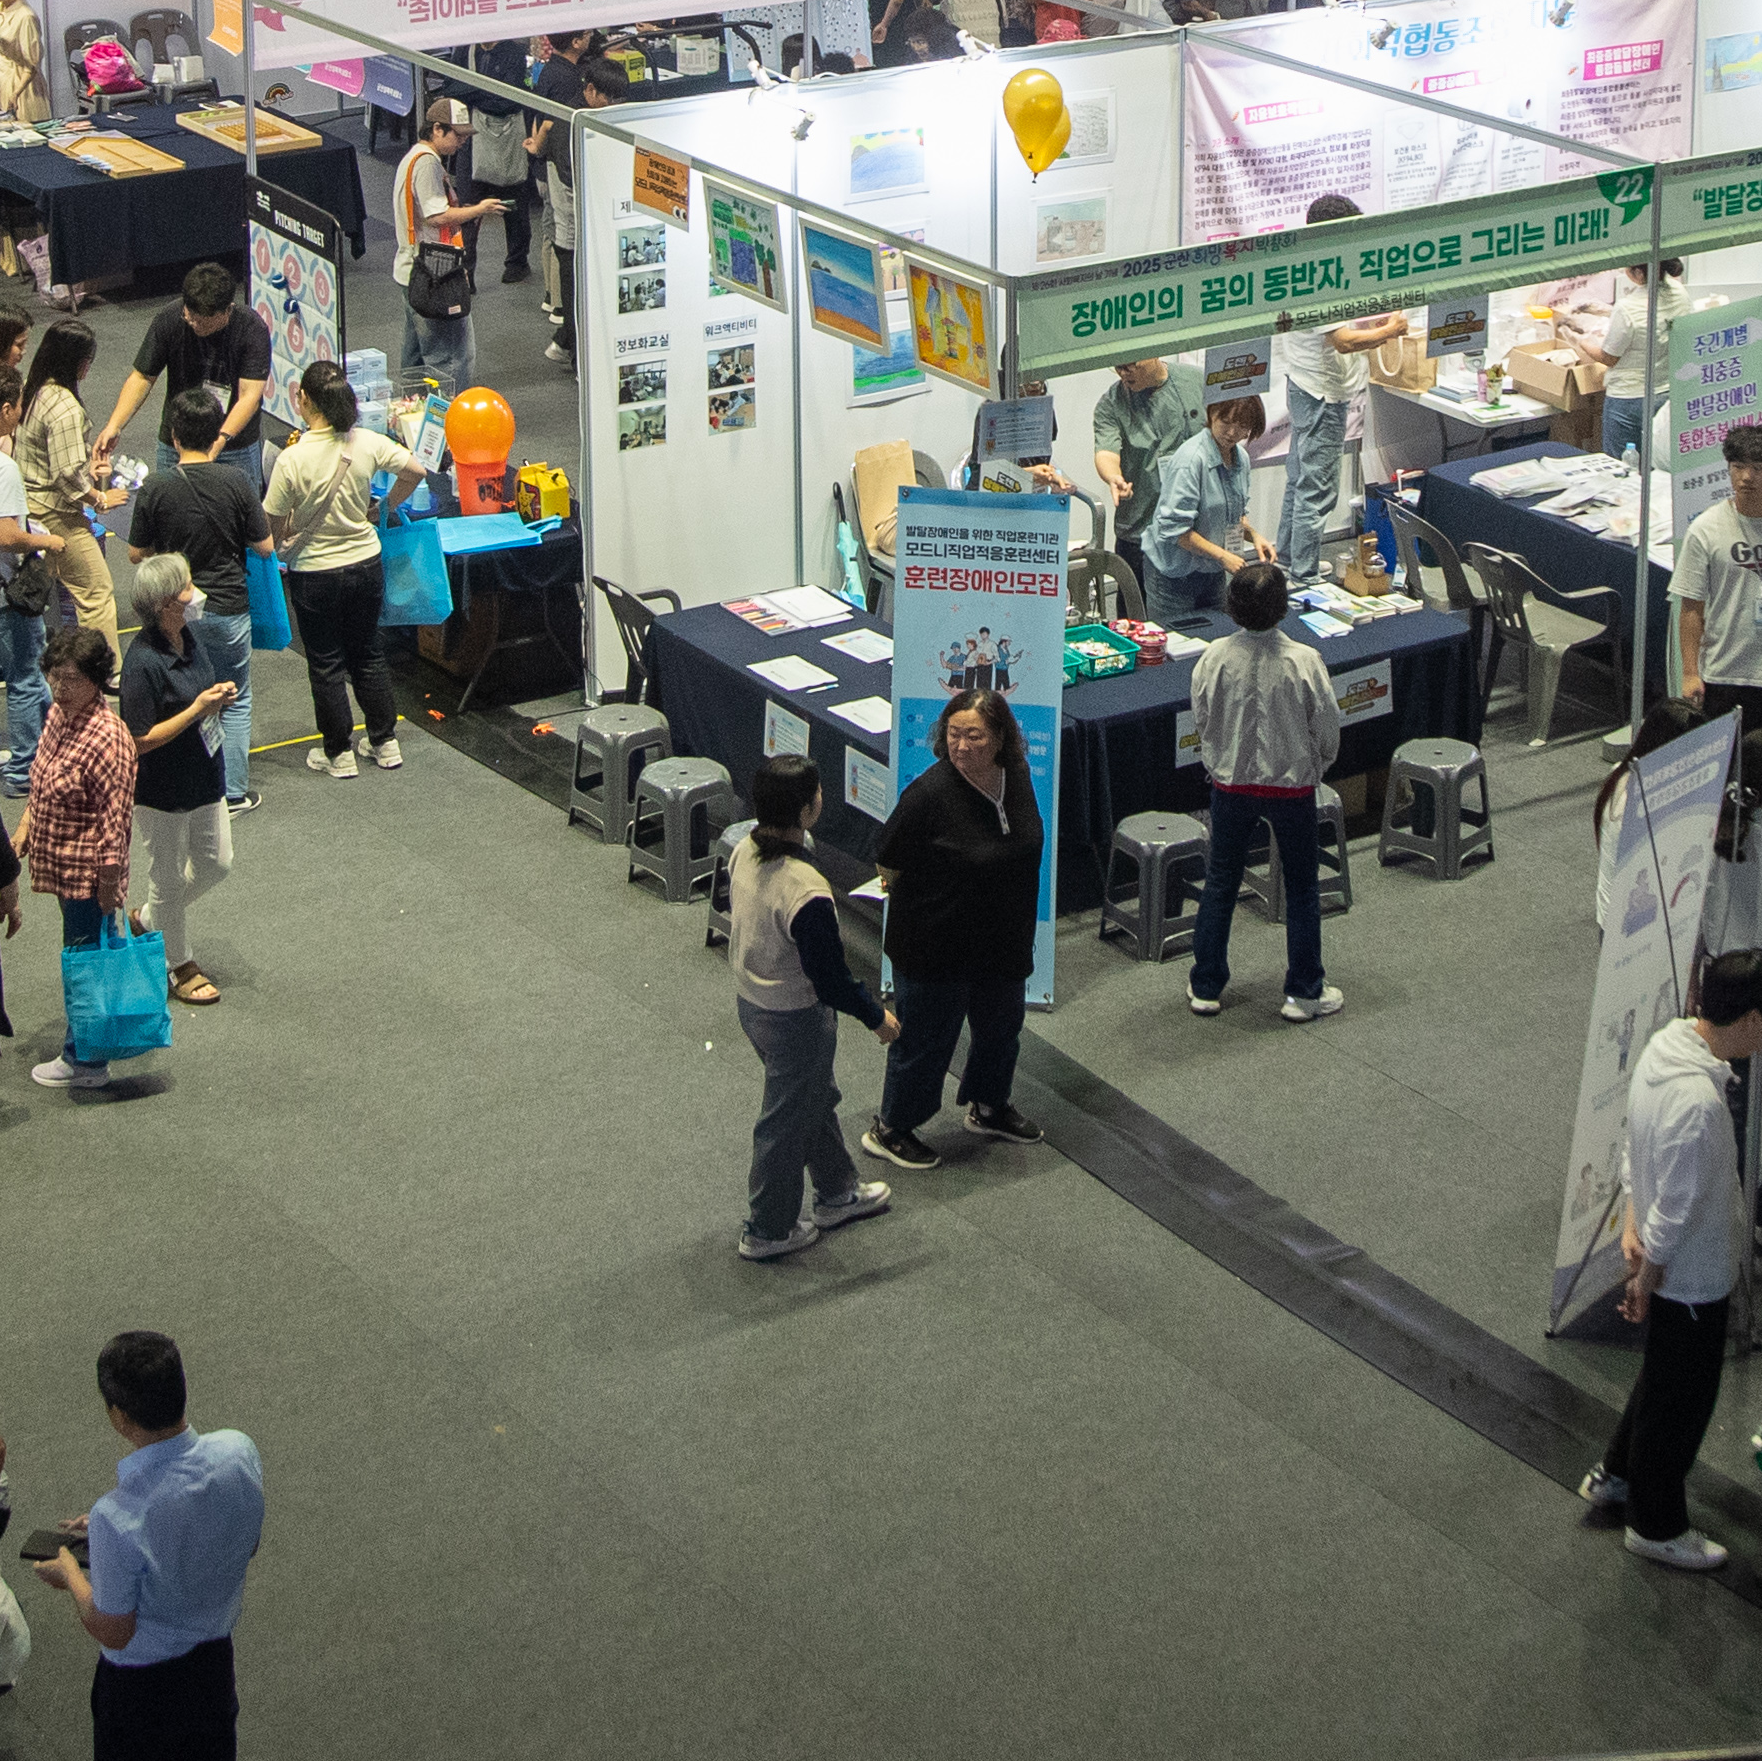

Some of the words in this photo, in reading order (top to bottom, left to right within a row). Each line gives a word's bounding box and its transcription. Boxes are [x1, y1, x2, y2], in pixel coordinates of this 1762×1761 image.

[1615, 174, 1644, 204] 22
[1070, 284, 1184, 338] 장애인의
[1199, 272, 1254, 314] 꿈의
[1262, 255, 1351, 305] 동반자,
[1359, 235, 1462, 280] 직업으로
[1470, 220, 1546, 263] 그리는
[1553, 206, 1611, 247] 미래!
[1122, 257, 1162, 279] 2025
[1163, 250, 1190, 270] 군산
[1223, 239, 1255, 261] 복지
[703, 318, 758, 337] 워크액티비티
[1693, 323, 1749, 356] 주간개별
[616, 333, 670, 354] 정보화교실
[1699, 356, 1743, 385] 최중증
[1686, 383, 1757, 421] 발달장애인
[905, 525, 970, 539] 발달장애인을
[972, 528, 993, 541] 위한
[995, 530, 1059, 546] 직업훈련기관
[905, 542, 1060, 565] 모드니직업적응훈련센터
[904, 565, 1059, 598] 훈련장애인모집
